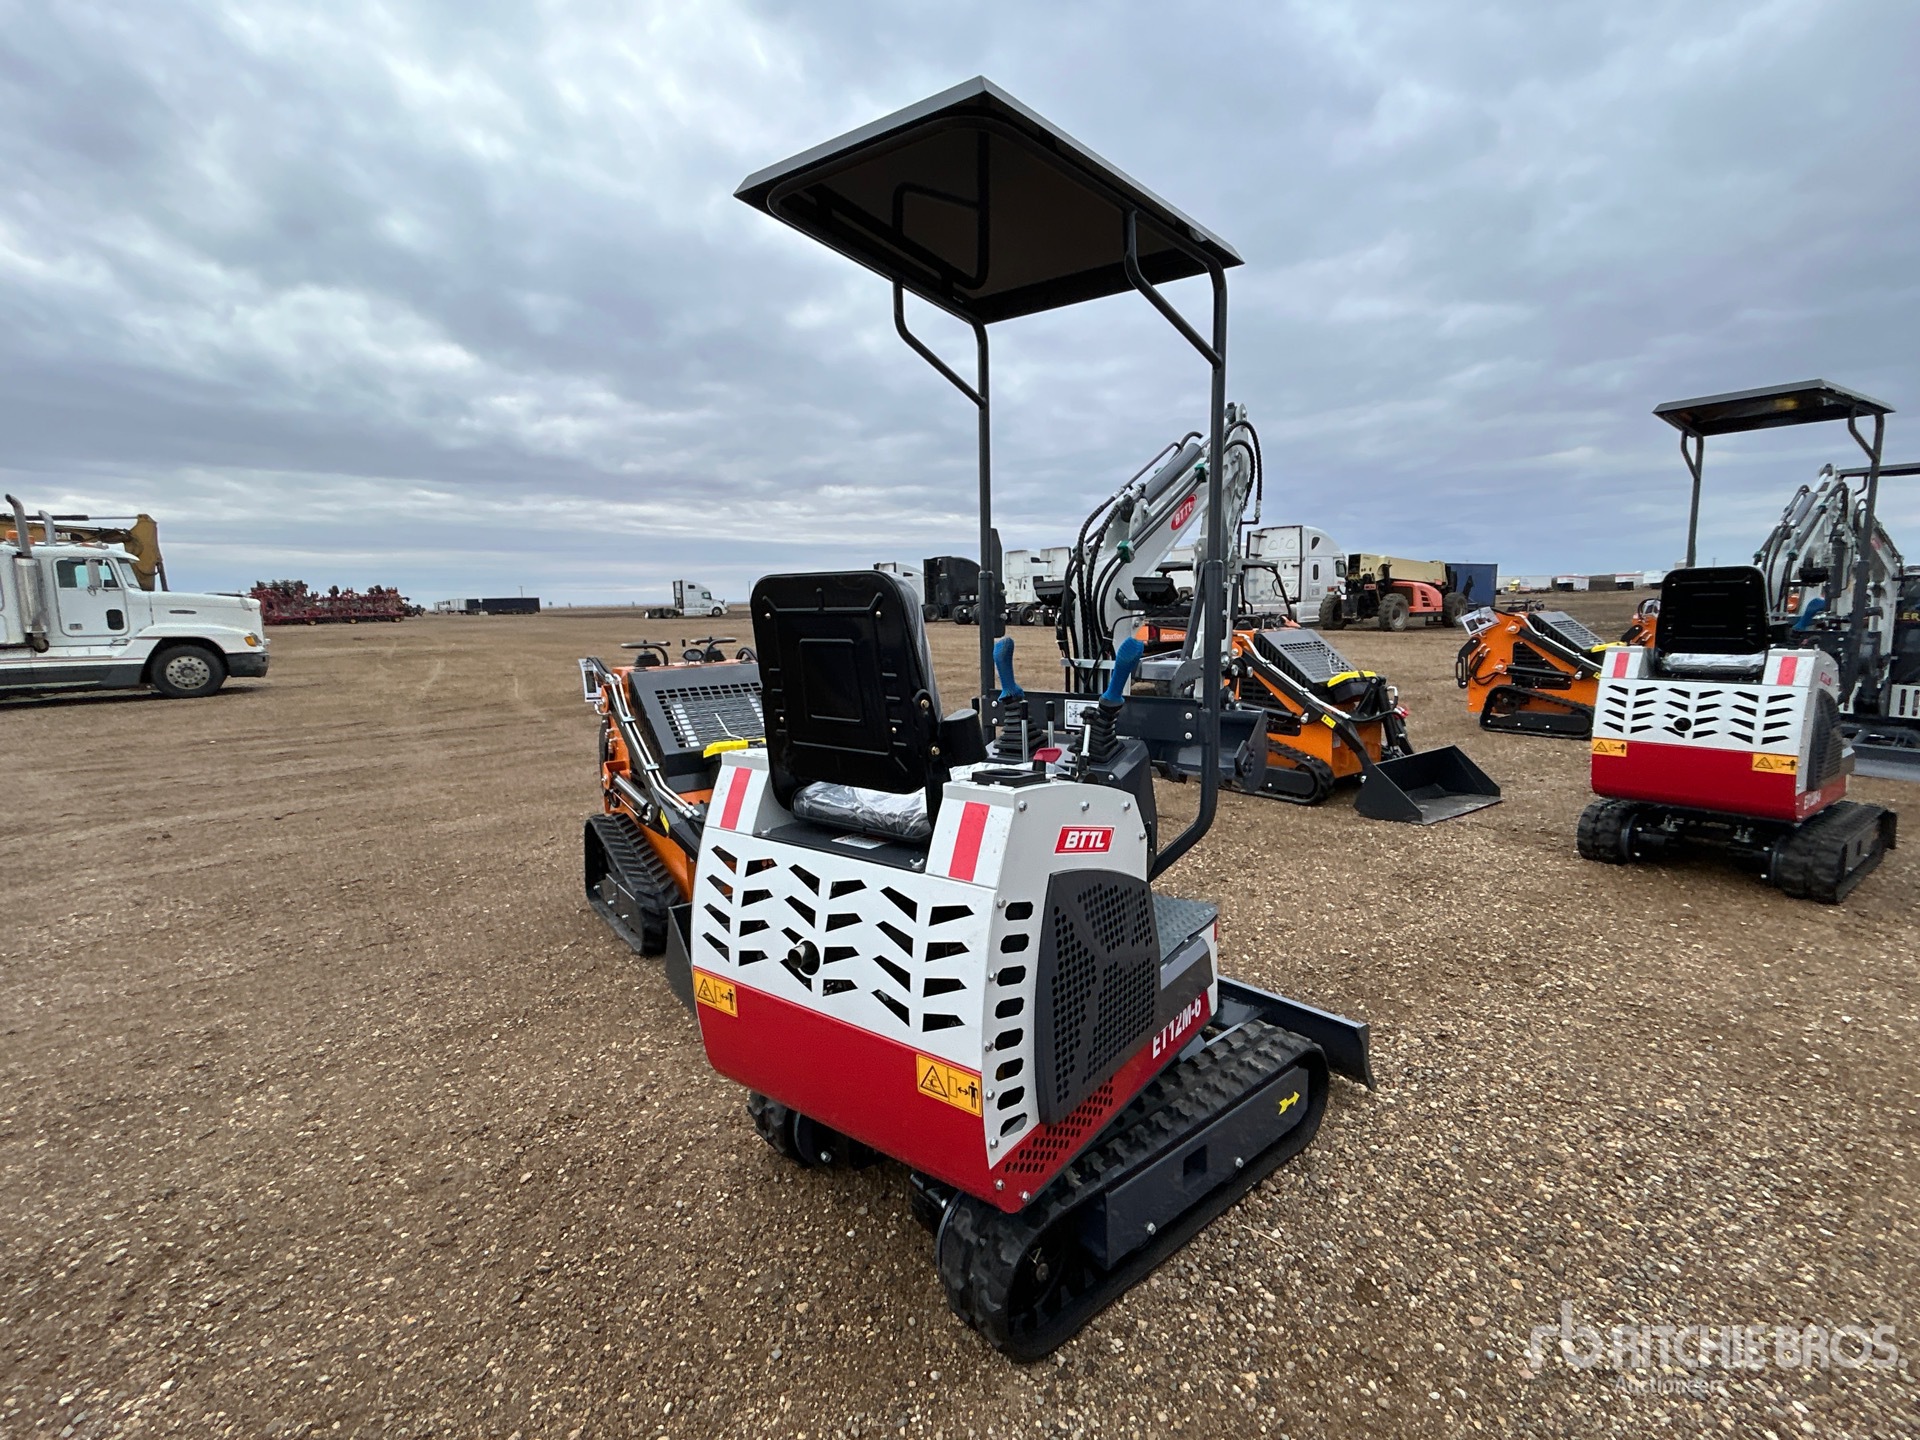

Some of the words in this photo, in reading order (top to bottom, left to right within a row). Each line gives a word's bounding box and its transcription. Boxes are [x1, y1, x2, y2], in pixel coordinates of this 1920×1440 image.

[1175, 501, 1193, 526] BTTL
[55, 532, 71, 540] CAT
[1064, 831, 1105, 849] BTTL
[1152, 994, 1202, 1060] ET12M-6
